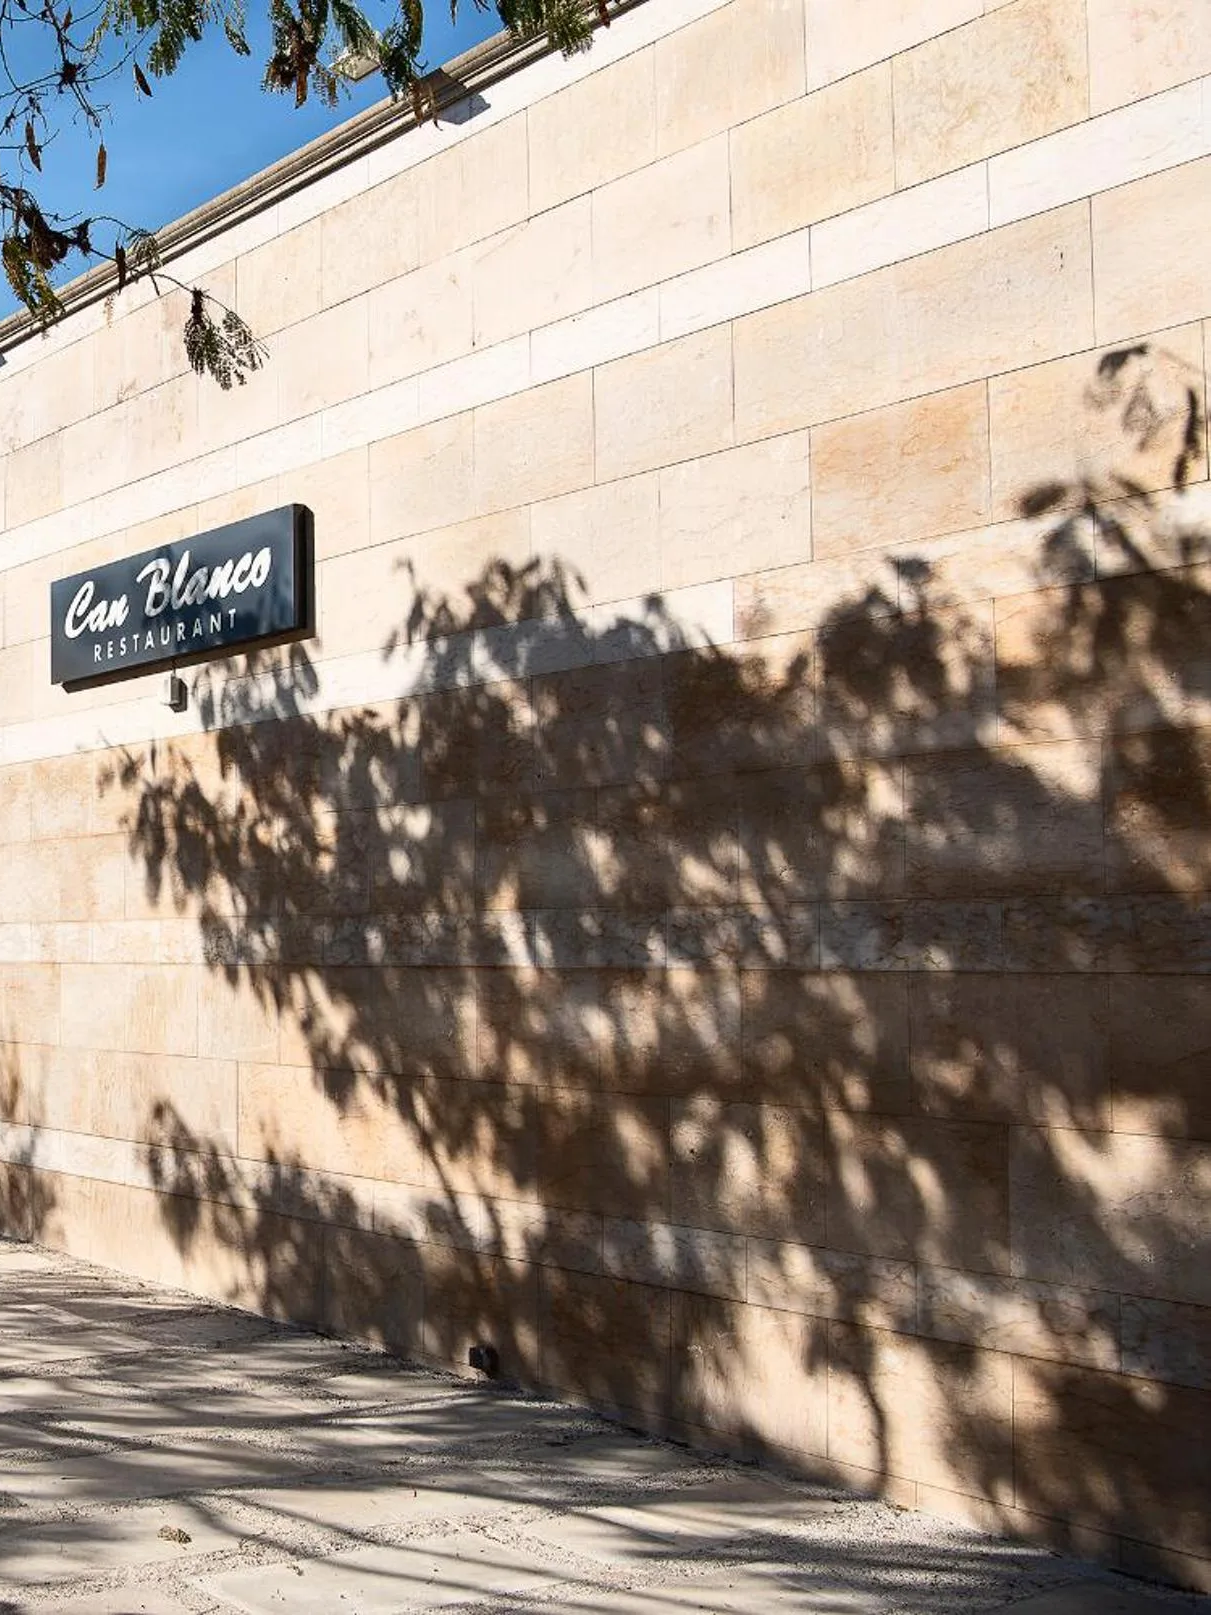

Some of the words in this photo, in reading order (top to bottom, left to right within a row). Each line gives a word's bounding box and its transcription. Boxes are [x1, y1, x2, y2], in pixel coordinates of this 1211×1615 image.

[64, 580, 130, 639] Can
[137, 547, 272, 617] Blanco
[94, 608, 237, 662] RESTAURANT
